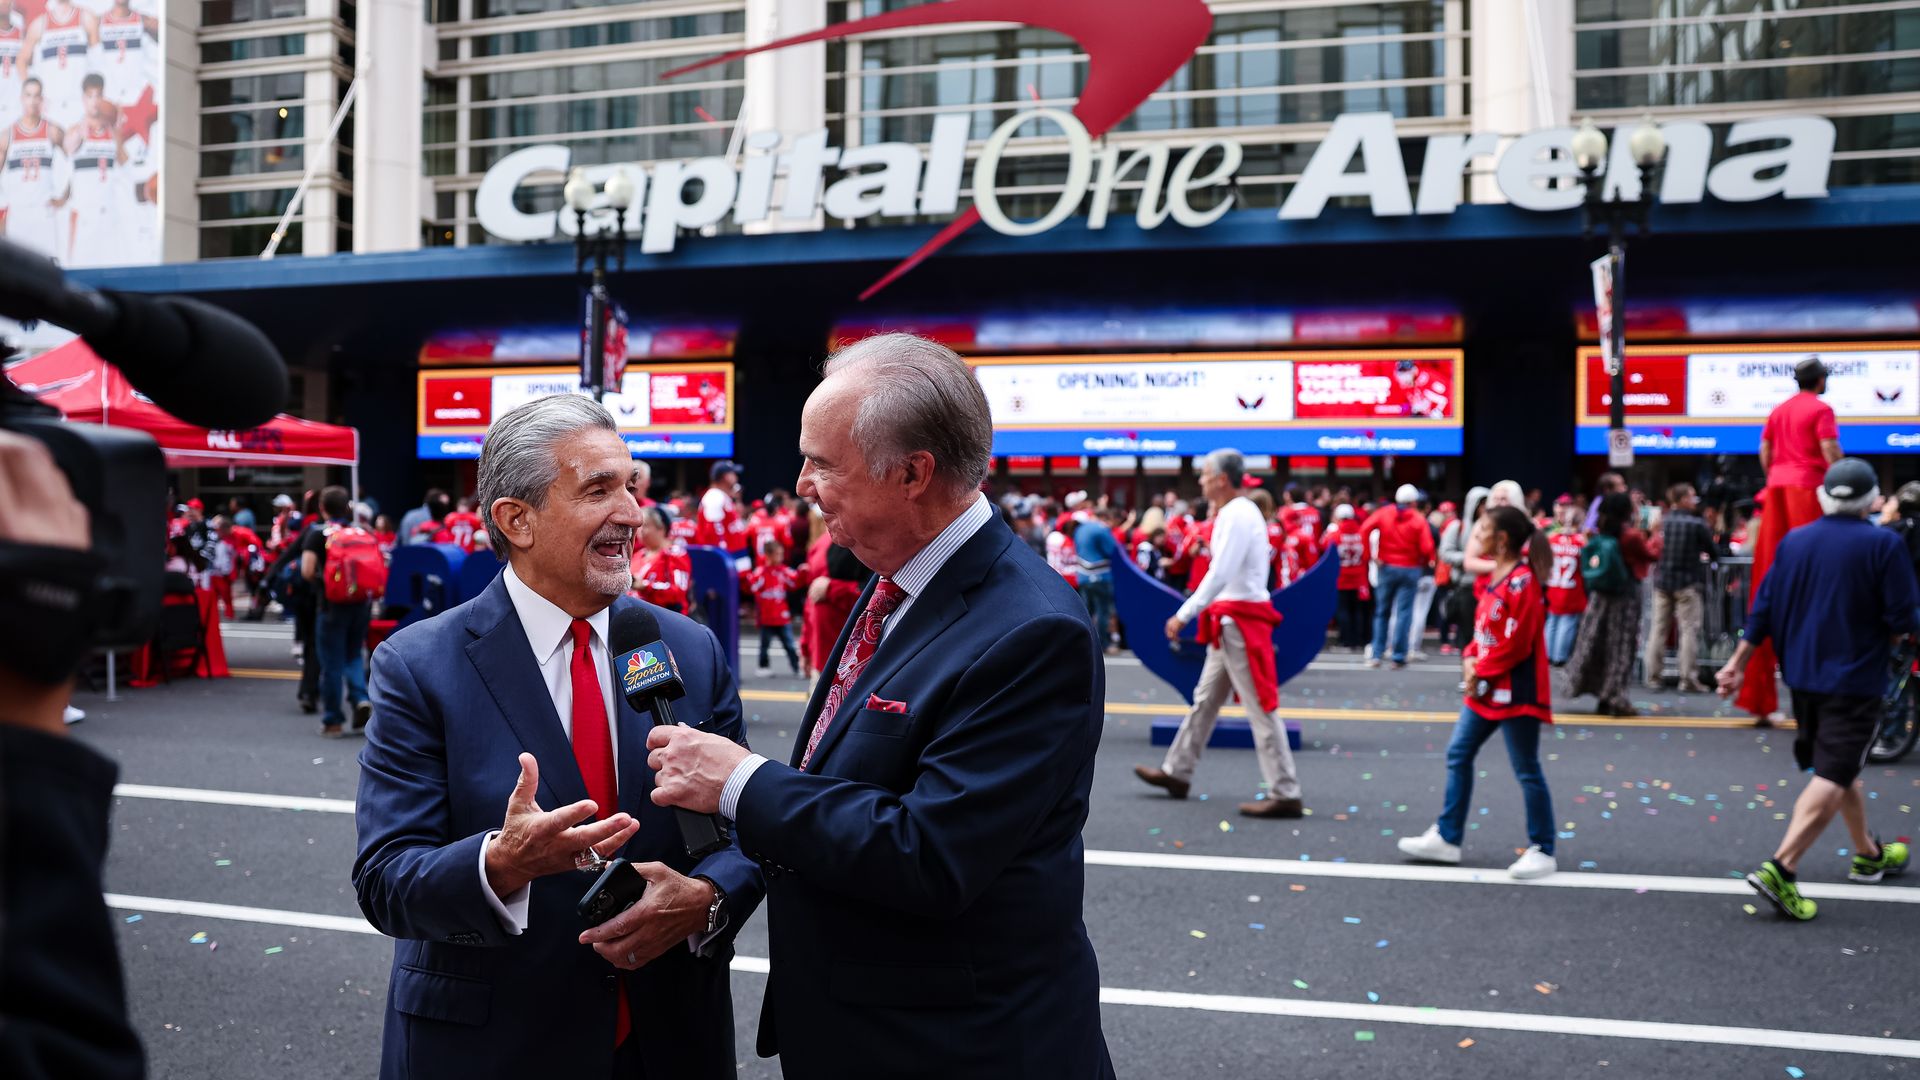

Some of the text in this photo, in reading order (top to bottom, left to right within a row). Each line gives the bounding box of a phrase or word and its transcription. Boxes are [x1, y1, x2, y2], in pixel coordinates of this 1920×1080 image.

[475, 108, 1836, 253] Capital One Arena
[624, 661, 666, 686] Sports
[625, 671, 670, 693] WASHINGTON
